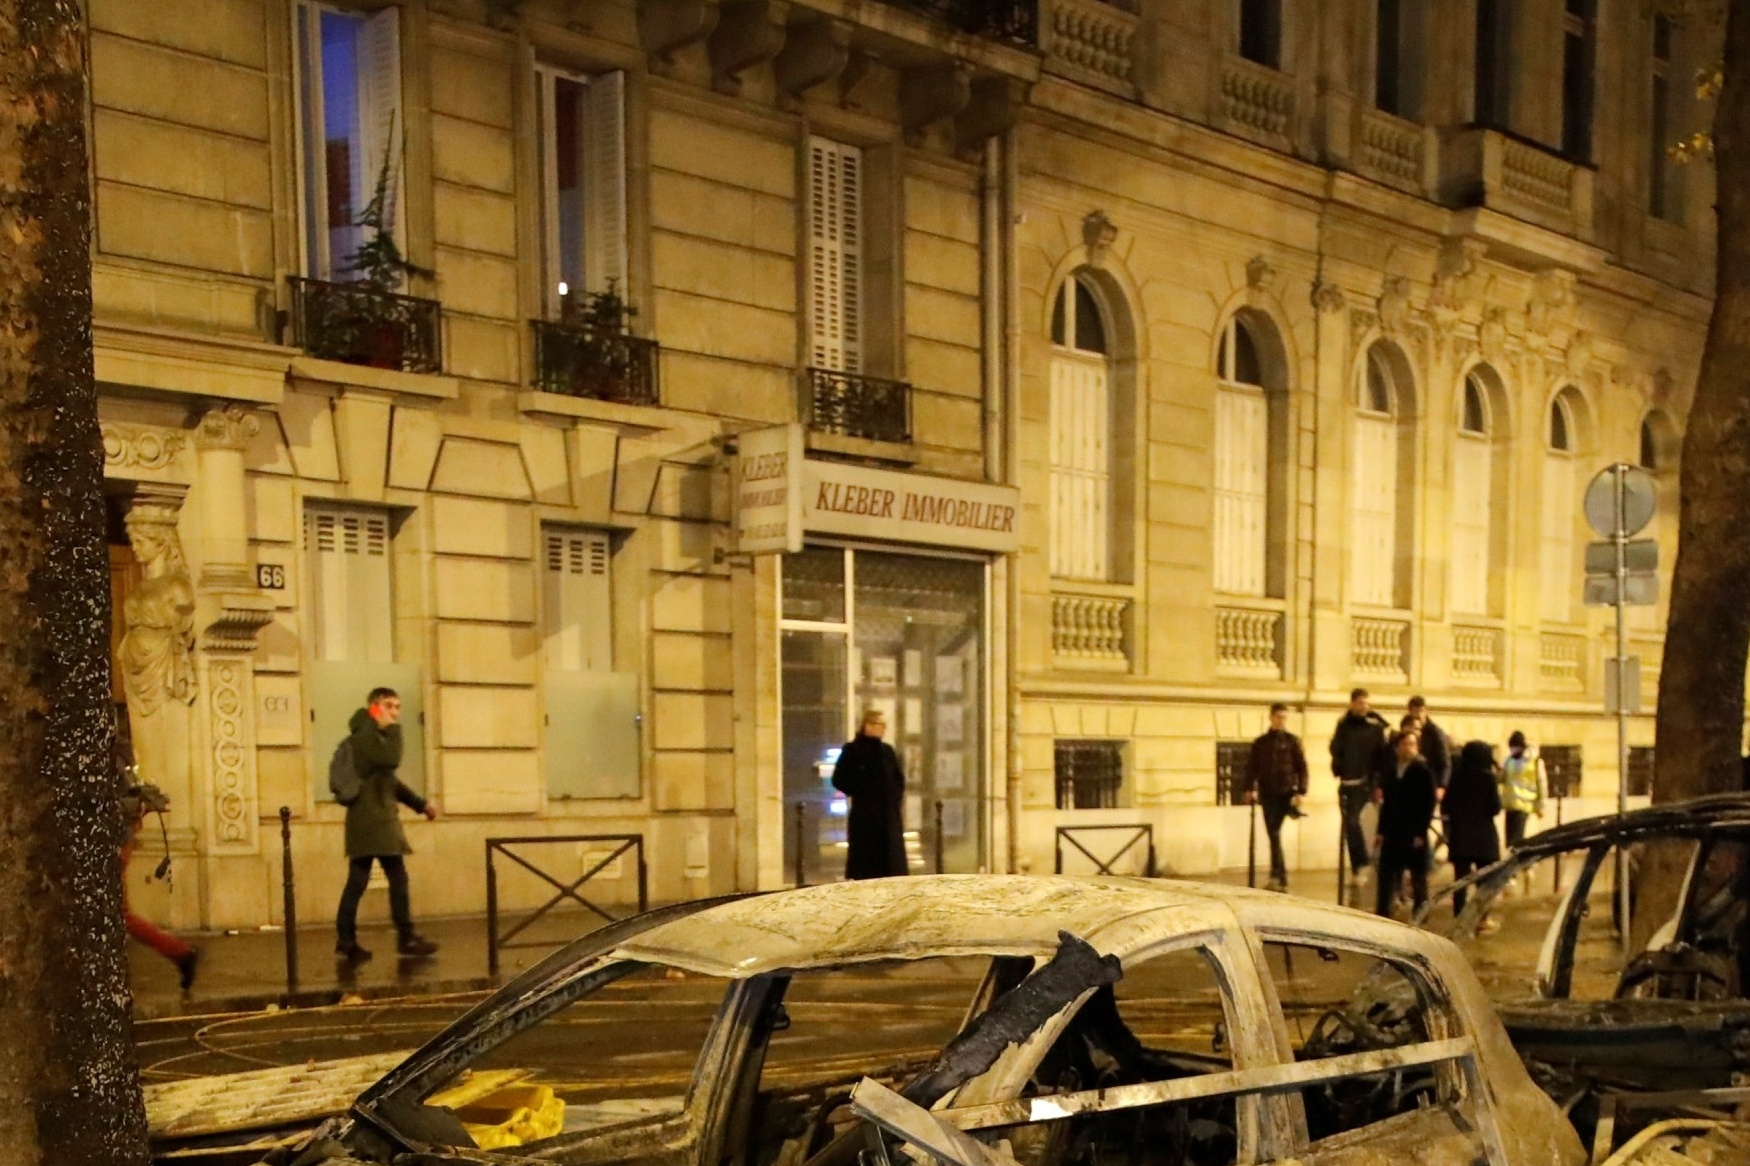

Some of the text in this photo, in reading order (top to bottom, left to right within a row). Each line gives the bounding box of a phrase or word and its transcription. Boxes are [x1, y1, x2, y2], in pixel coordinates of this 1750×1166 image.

[815, 481, 895, 518] KLEBER
[902, 493, 1016, 532] IMMOBILIER
[260, 566, 284, 587] 66
